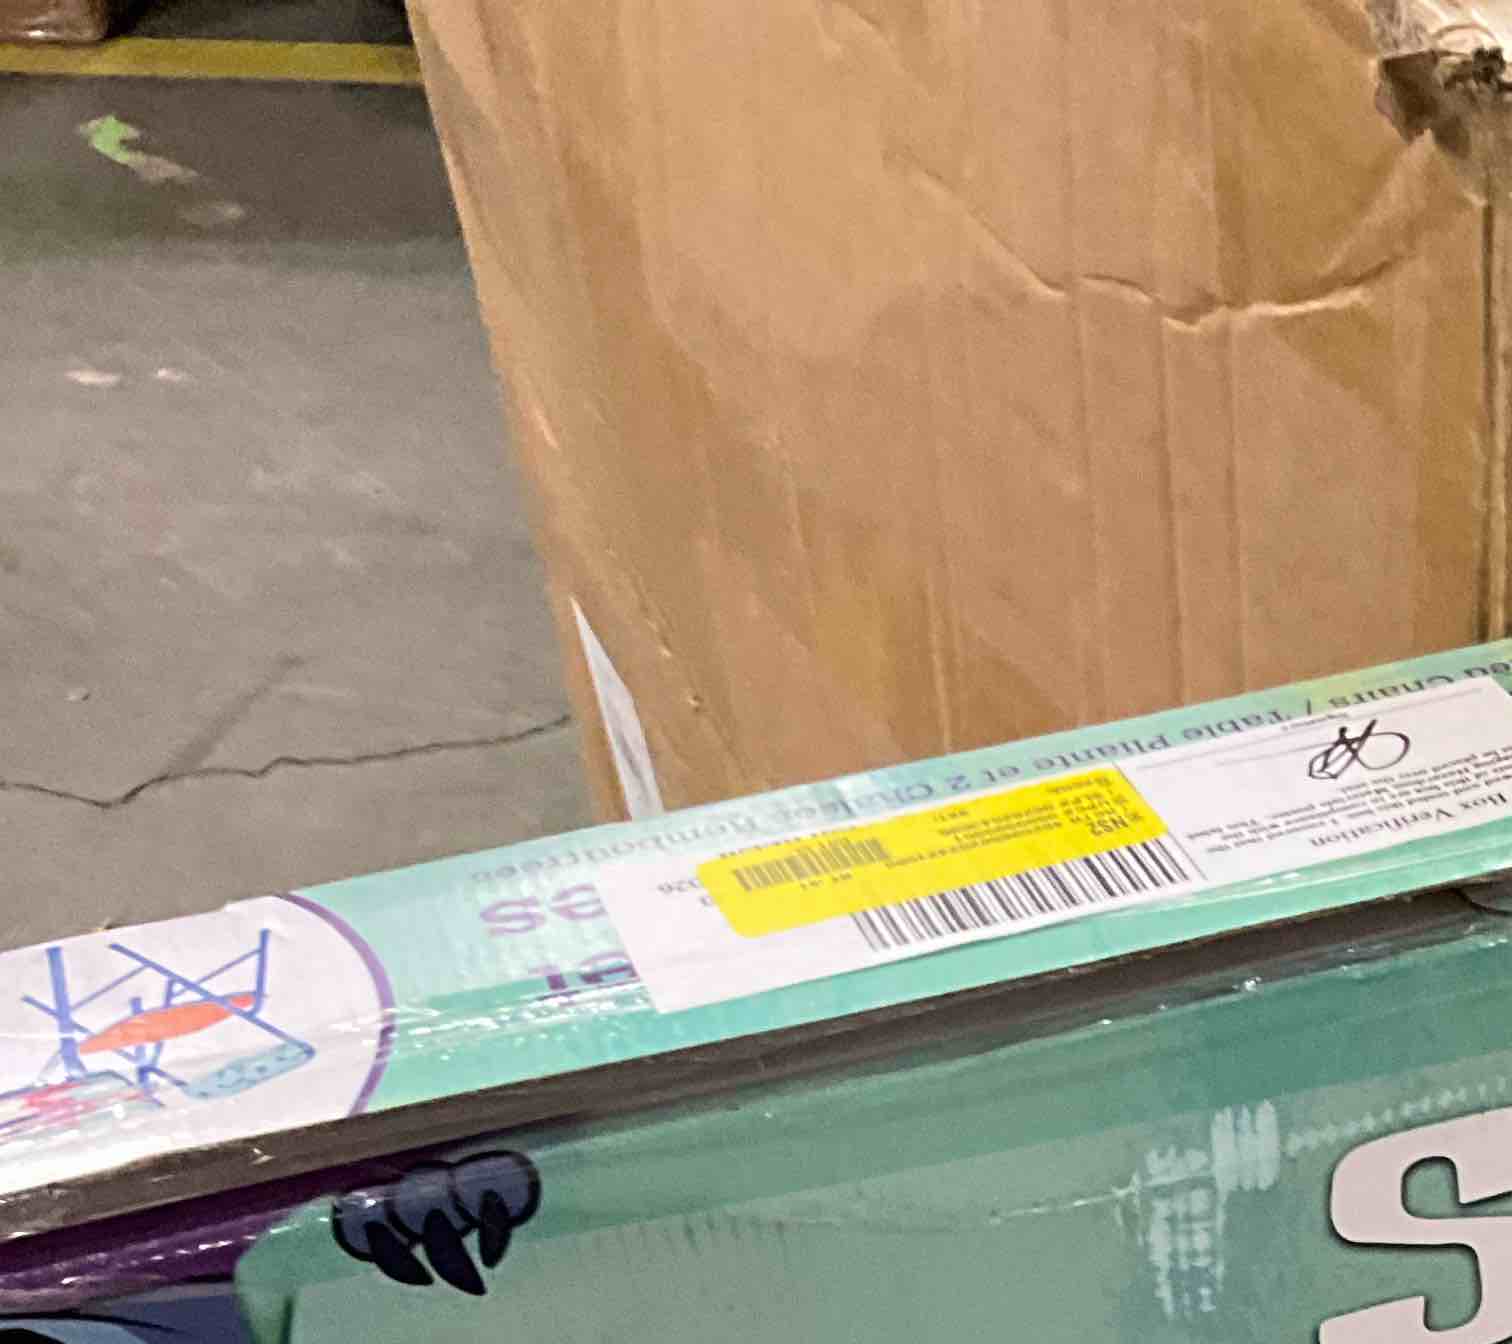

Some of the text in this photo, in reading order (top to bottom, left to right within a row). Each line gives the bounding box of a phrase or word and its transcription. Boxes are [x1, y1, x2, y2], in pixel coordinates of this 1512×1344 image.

[1182, 709, 1292, 743] Table
[1033, 733, 1172, 773] Pliante
[946, 772, 972, 793] 2
[982, 763, 1021, 785] et
